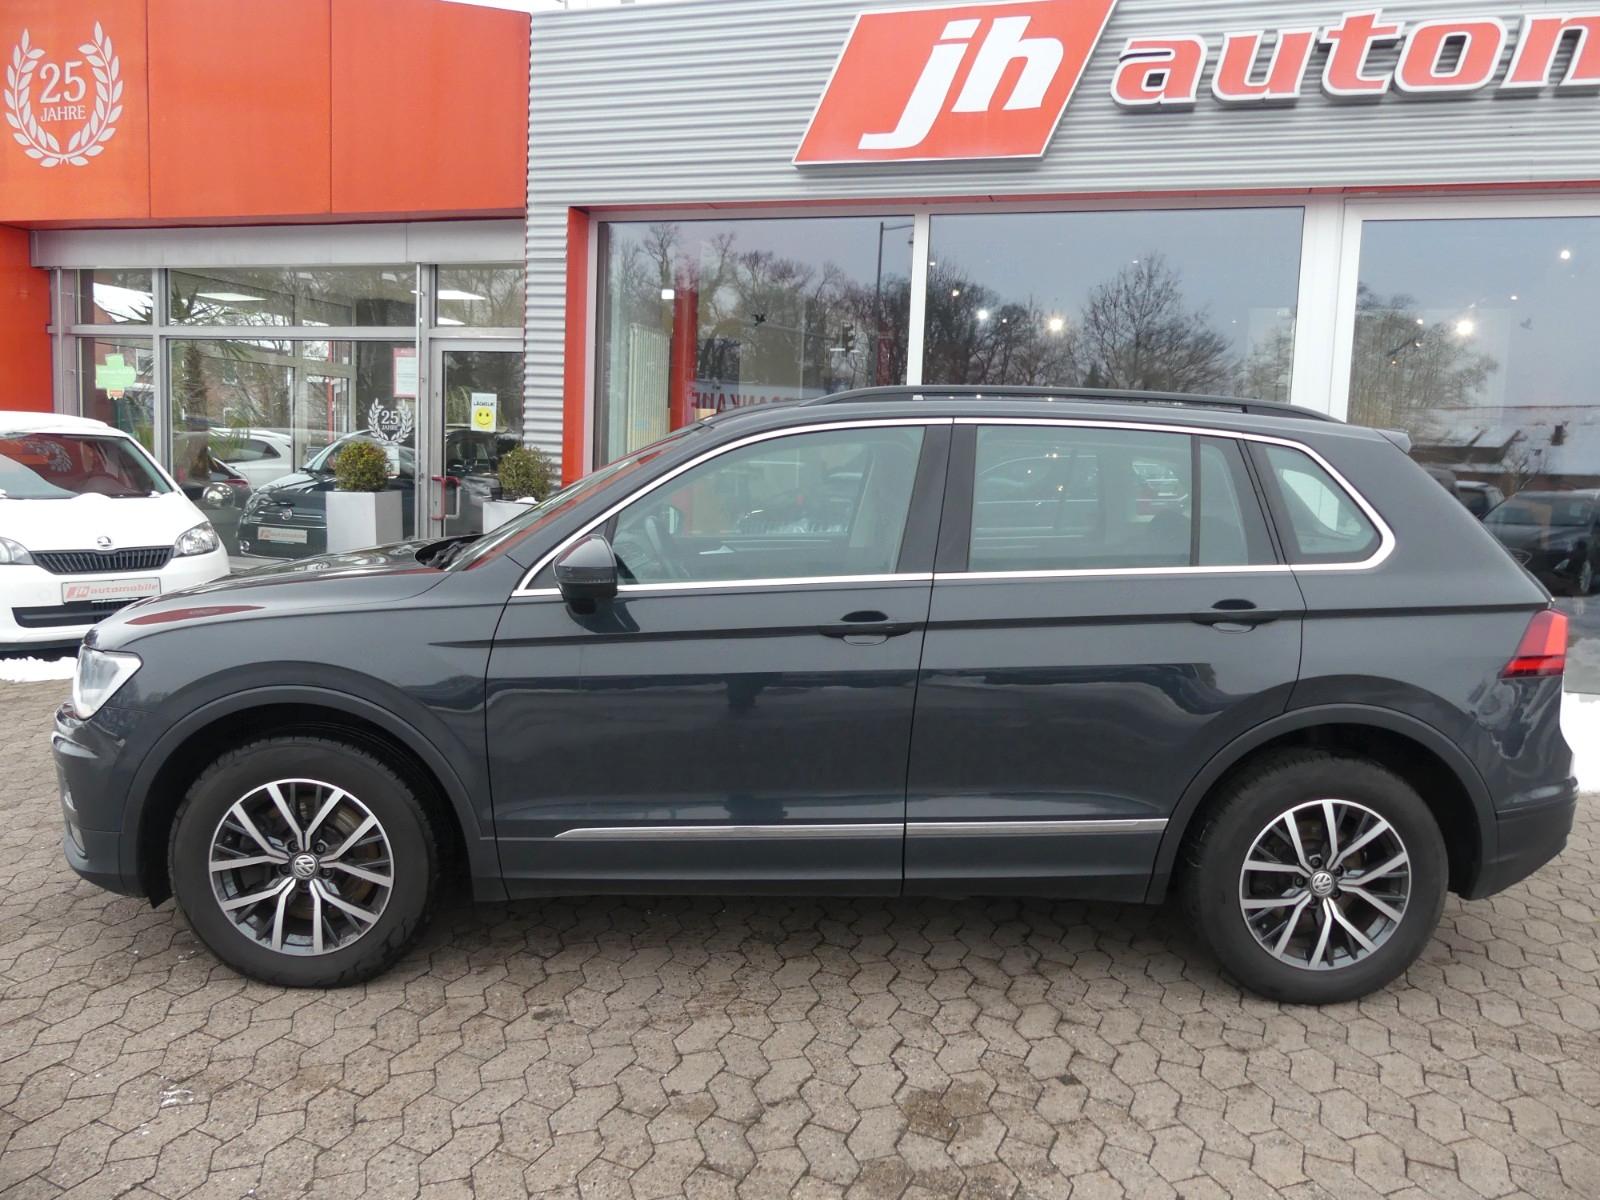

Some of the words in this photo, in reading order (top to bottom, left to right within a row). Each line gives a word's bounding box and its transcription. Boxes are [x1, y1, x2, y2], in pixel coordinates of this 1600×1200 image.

[39, 61, 87, 104] 25
[857, 15, 1064, 150] jh
[41, 105, 87, 122] JAHRE
[380, 409, 399, 425] 25
[90, 583, 159, 594] automobile
